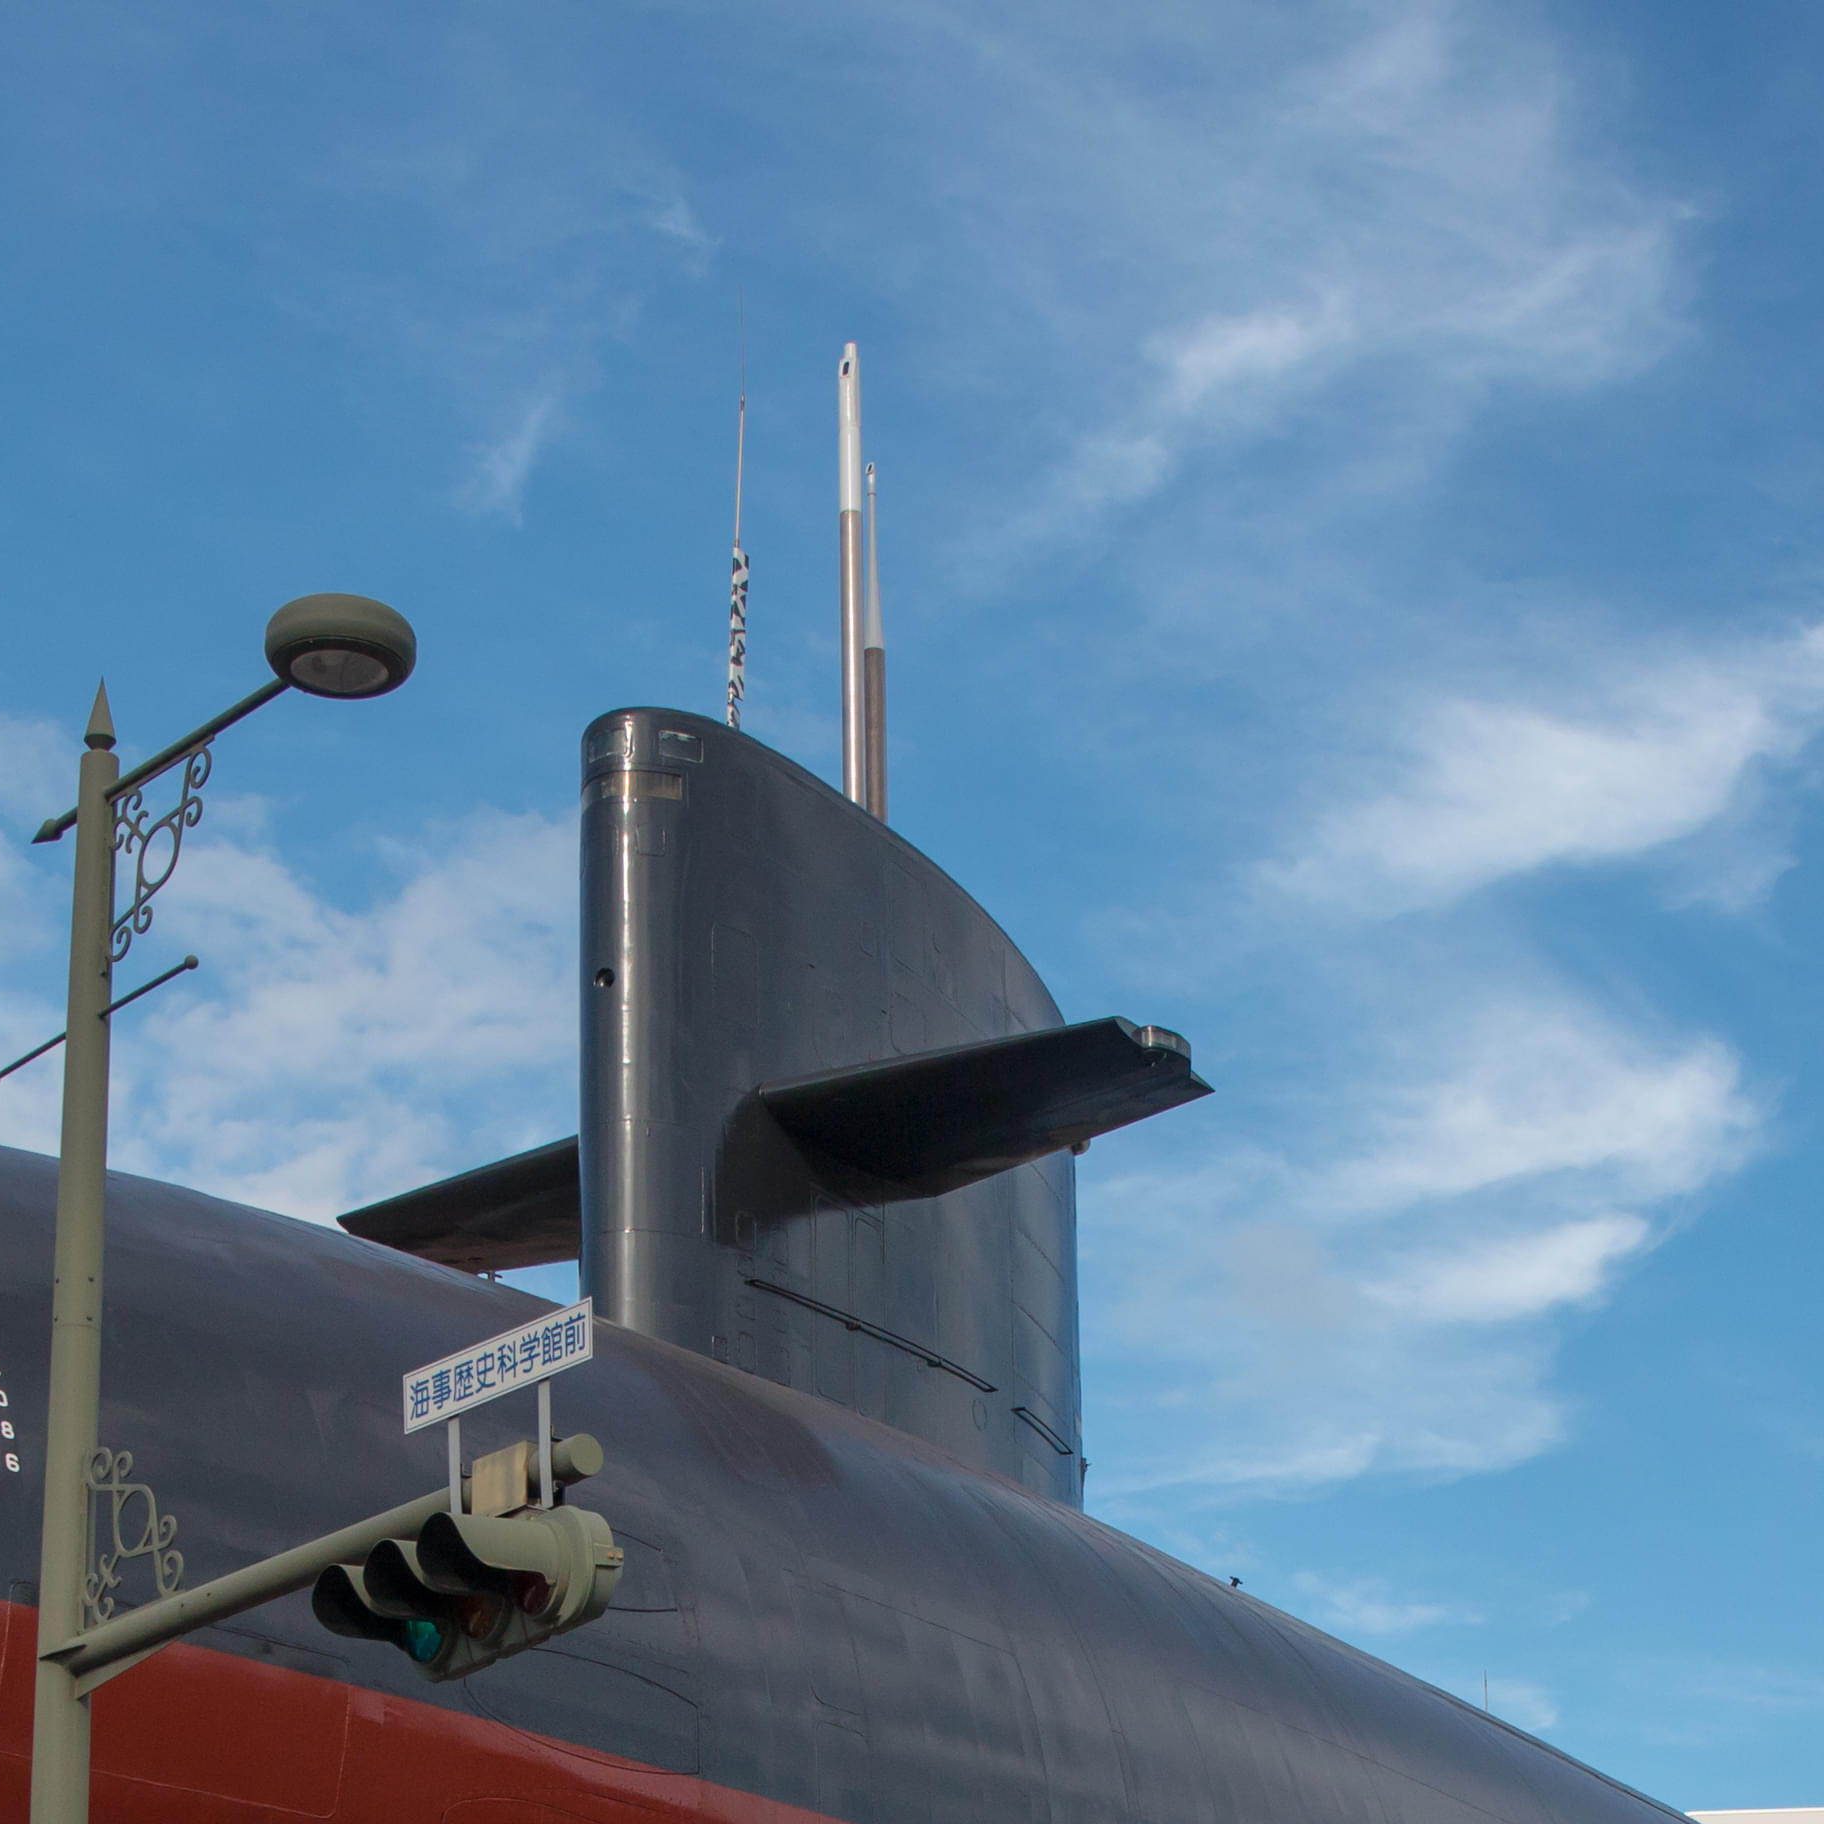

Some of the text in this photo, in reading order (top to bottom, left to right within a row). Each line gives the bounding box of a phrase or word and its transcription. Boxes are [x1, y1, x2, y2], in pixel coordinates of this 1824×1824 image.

[410, 1312, 586, 1421] 海事歴史科学館前
[0, 1420, 15, 1439] 8
[5, 1453, 20, 1472] 6
